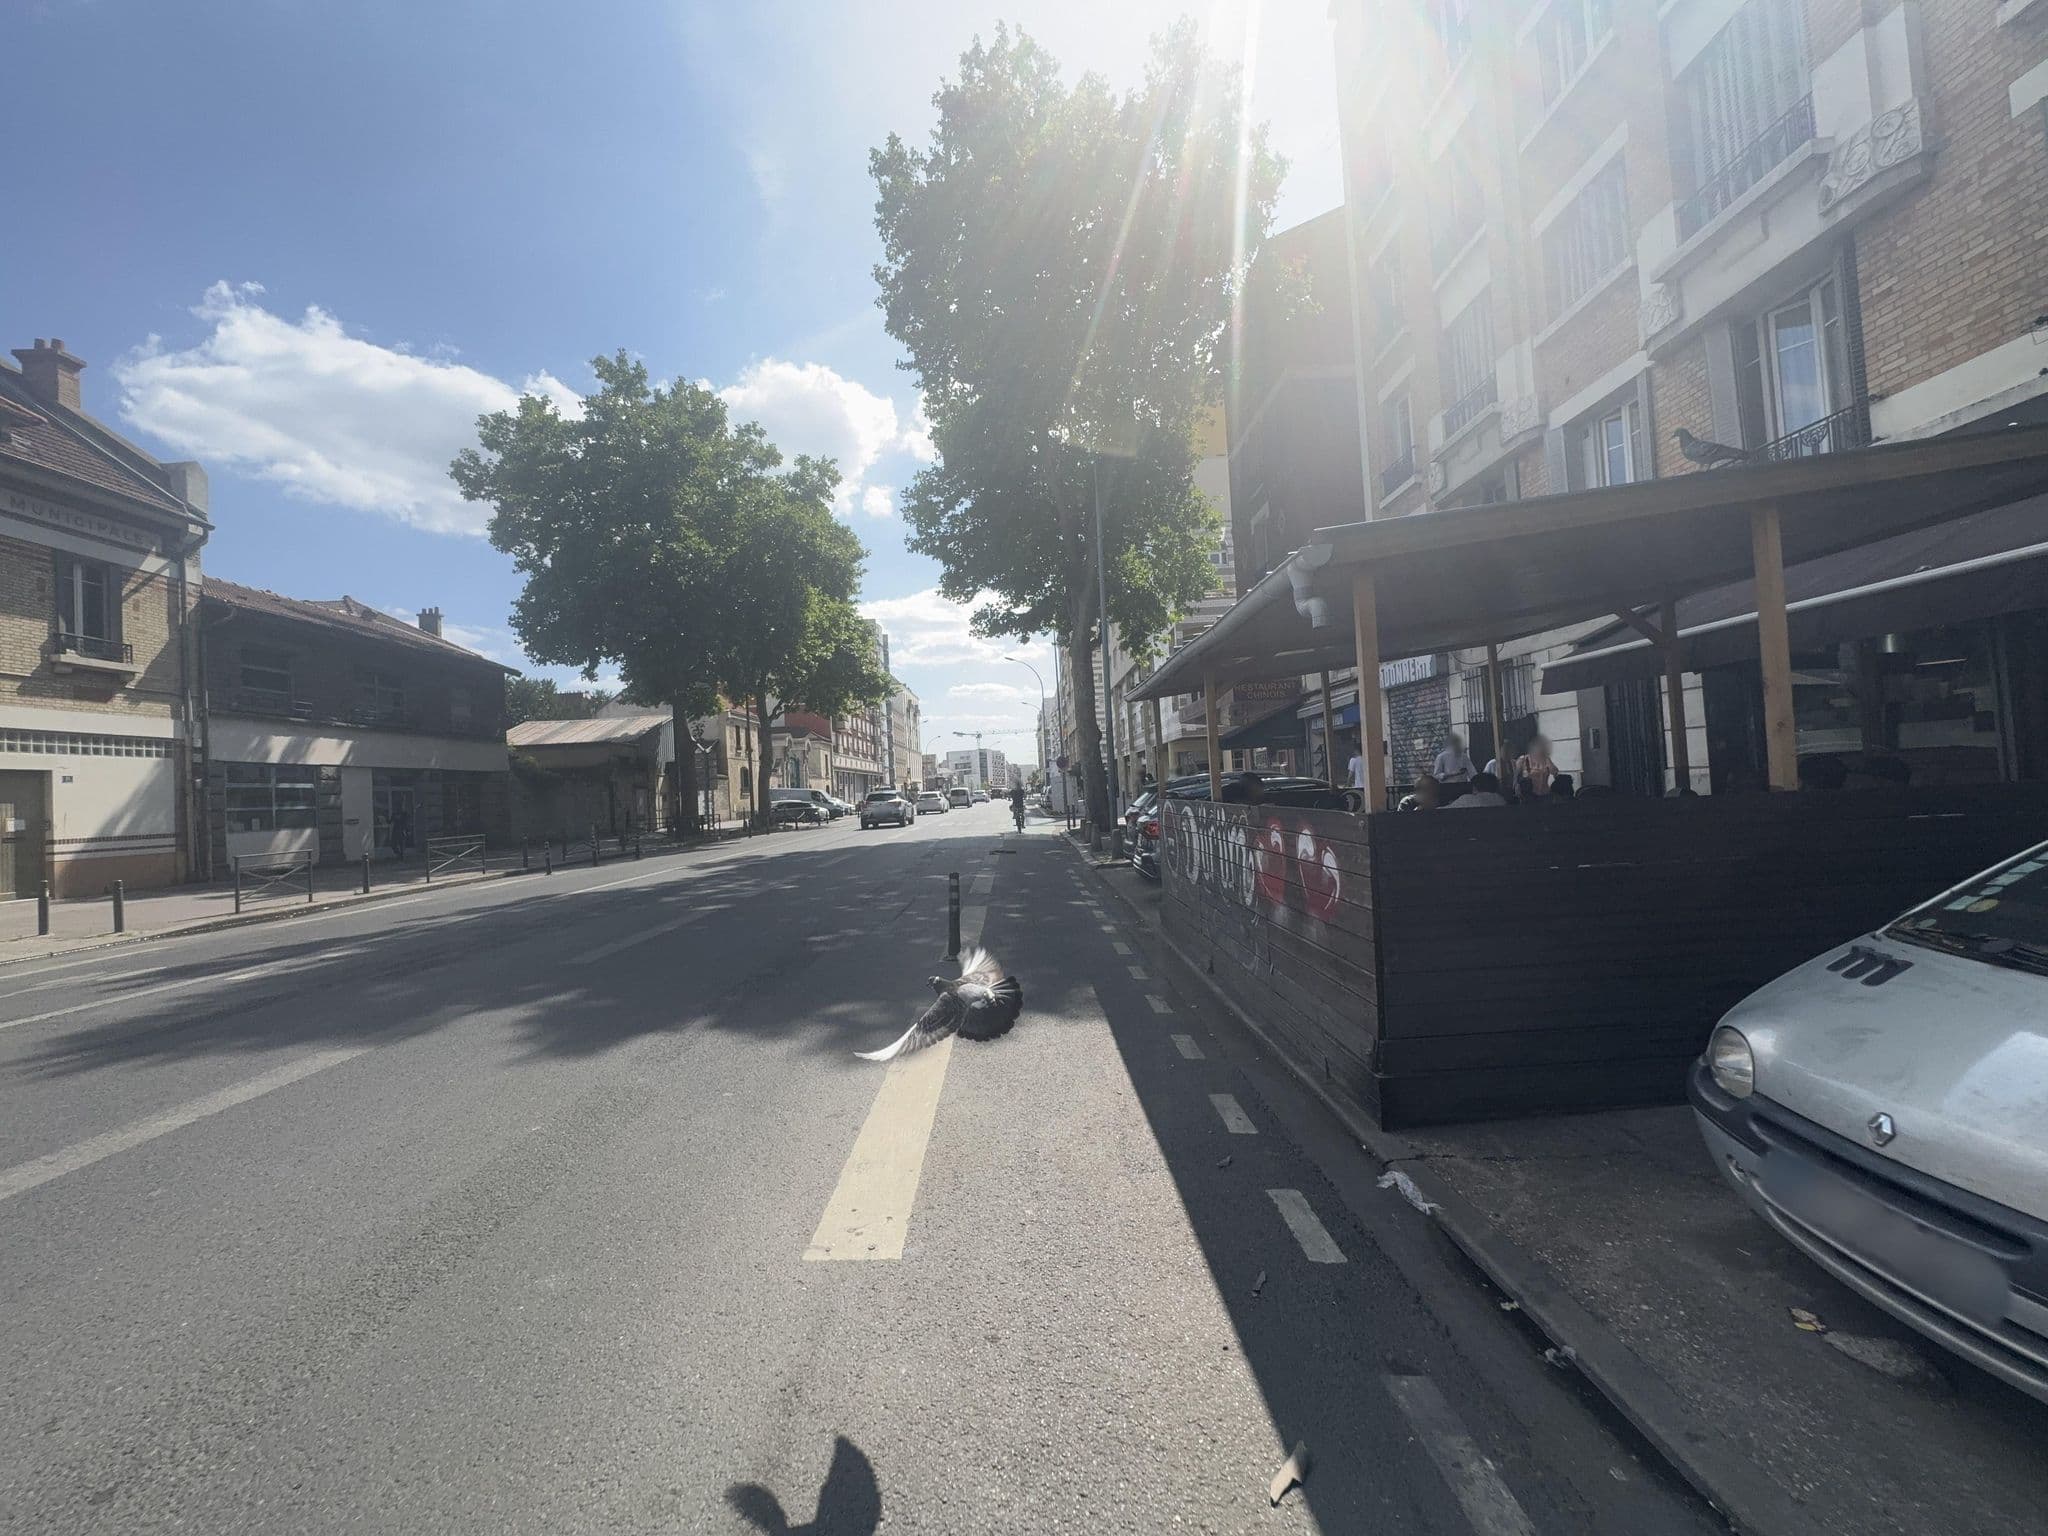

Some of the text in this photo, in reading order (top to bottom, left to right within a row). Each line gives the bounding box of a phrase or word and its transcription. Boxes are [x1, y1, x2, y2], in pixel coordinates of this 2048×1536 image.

[9, 496, 144, 545] MUNICIPALE
[1234, 681, 1296, 692] RESTAURANT
[1247, 689, 1286, 700] CHINOIS
